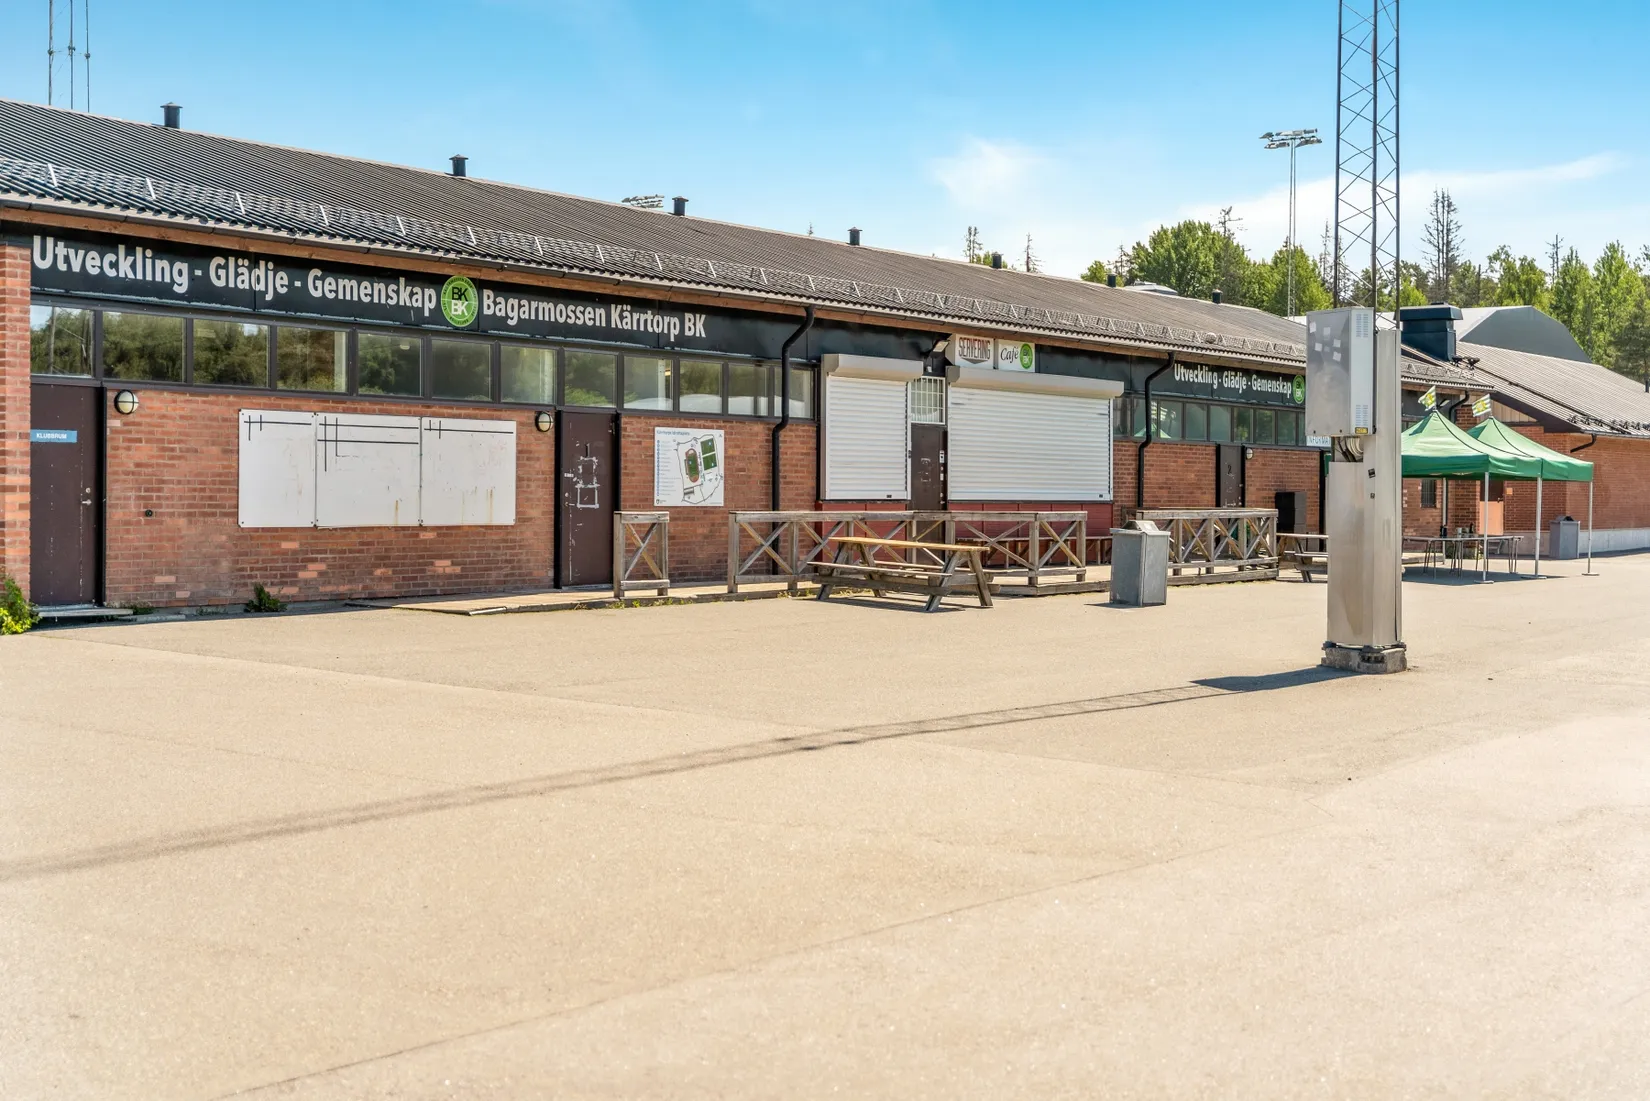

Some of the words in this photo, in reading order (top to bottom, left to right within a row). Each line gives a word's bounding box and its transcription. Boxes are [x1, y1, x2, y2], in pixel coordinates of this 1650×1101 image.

[33, 234, 189, 294] Utveckling
[209, 256, 289, 301] Glädje
[307, 268, 437, 317] Gemenskap
[451, 286, 468, 301] BK
[451, 300, 469, 316] BK
[482, 288, 606, 326] Bagarmossen
[610, 303, 680, 342] Kärrtorp
[684, 312, 707, 338] BK
[959, 337, 991, 360] SERVERING
[1000, 345, 1019, 364] Café
[1174, 363, 1218, 389] Utveckling
[1222, 370, 1247, 394] Glädje
[1251, 374, 1292, 398] Gemenskap
